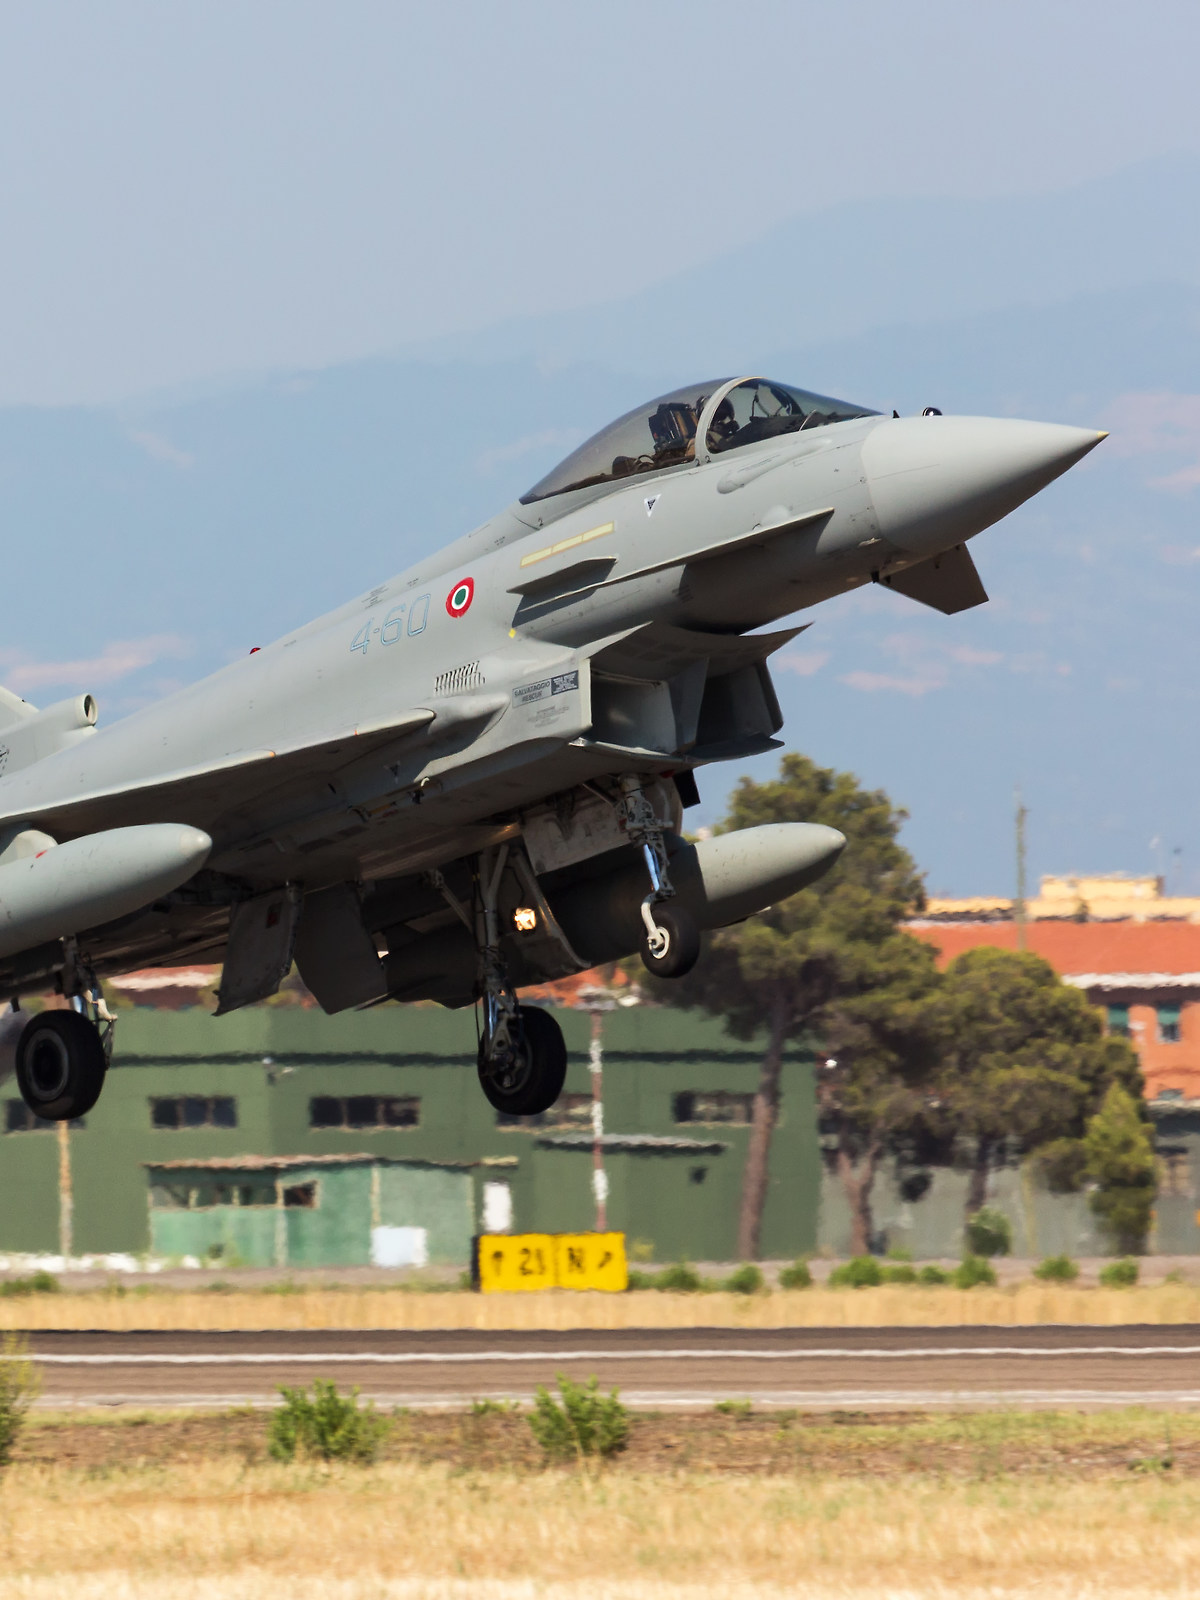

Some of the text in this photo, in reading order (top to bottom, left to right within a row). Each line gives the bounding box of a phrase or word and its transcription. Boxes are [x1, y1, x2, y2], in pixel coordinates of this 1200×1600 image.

[350, 593, 431, 654] 4-60
[514, 681, 551, 697] SALVATAGGIO
[519, 1248, 546, 1276] 21
